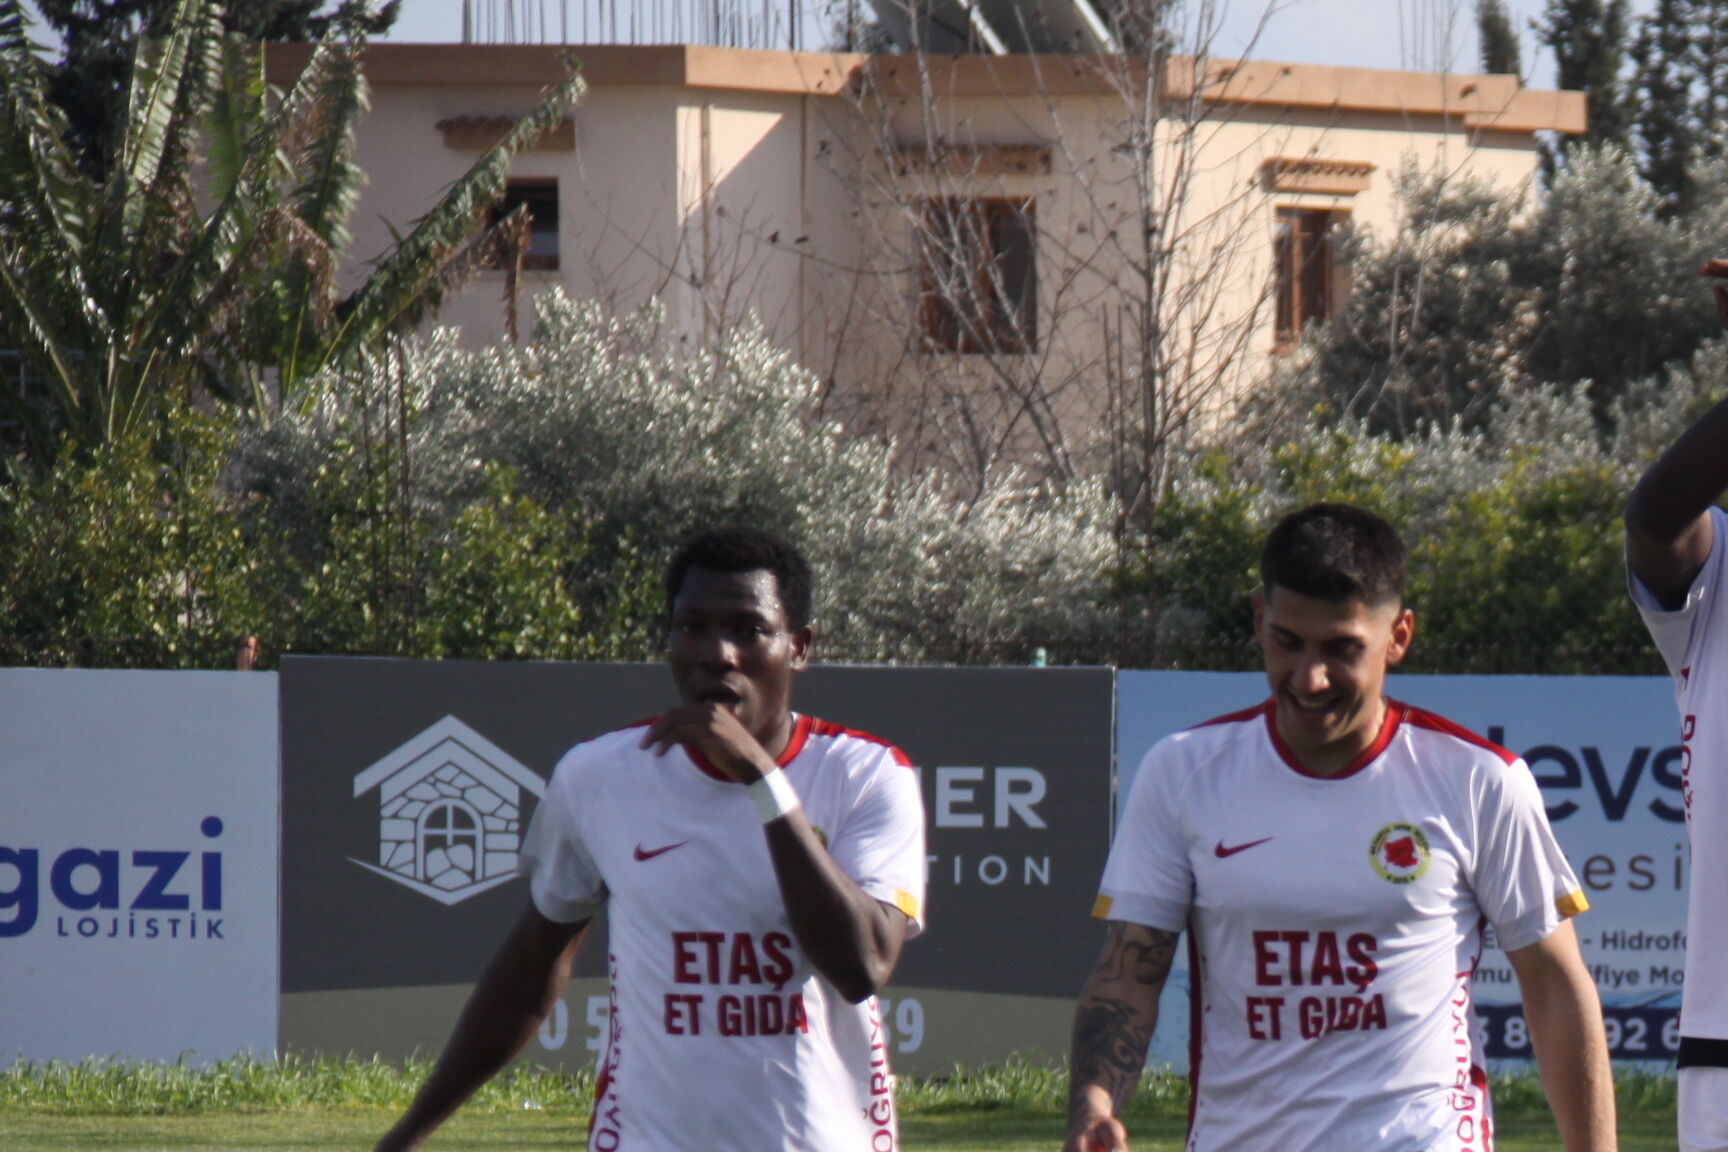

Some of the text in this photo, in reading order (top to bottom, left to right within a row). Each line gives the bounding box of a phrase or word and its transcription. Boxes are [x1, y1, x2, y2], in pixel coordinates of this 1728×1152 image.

[913, 766, 1048, 828] ER
[1488, 726, 1687, 824] evs
[926, 855, 1050, 886] TION
[1582, 844, 1683, 892] esi
[57, 912, 224, 939] LOJİSTİK
[671, 931, 794, 991] ETAŞ
[1253, 931, 1378, 993] ETAŞ
[1589, 964, 1640, 989] fiye
[1650, 966, 1685, 985] Mo
[664, 994, 808, 1037] ET GIDA
[1247, 994, 1387, 1041] ET GIDA
[1662, 1017, 1681, 1050] 6
